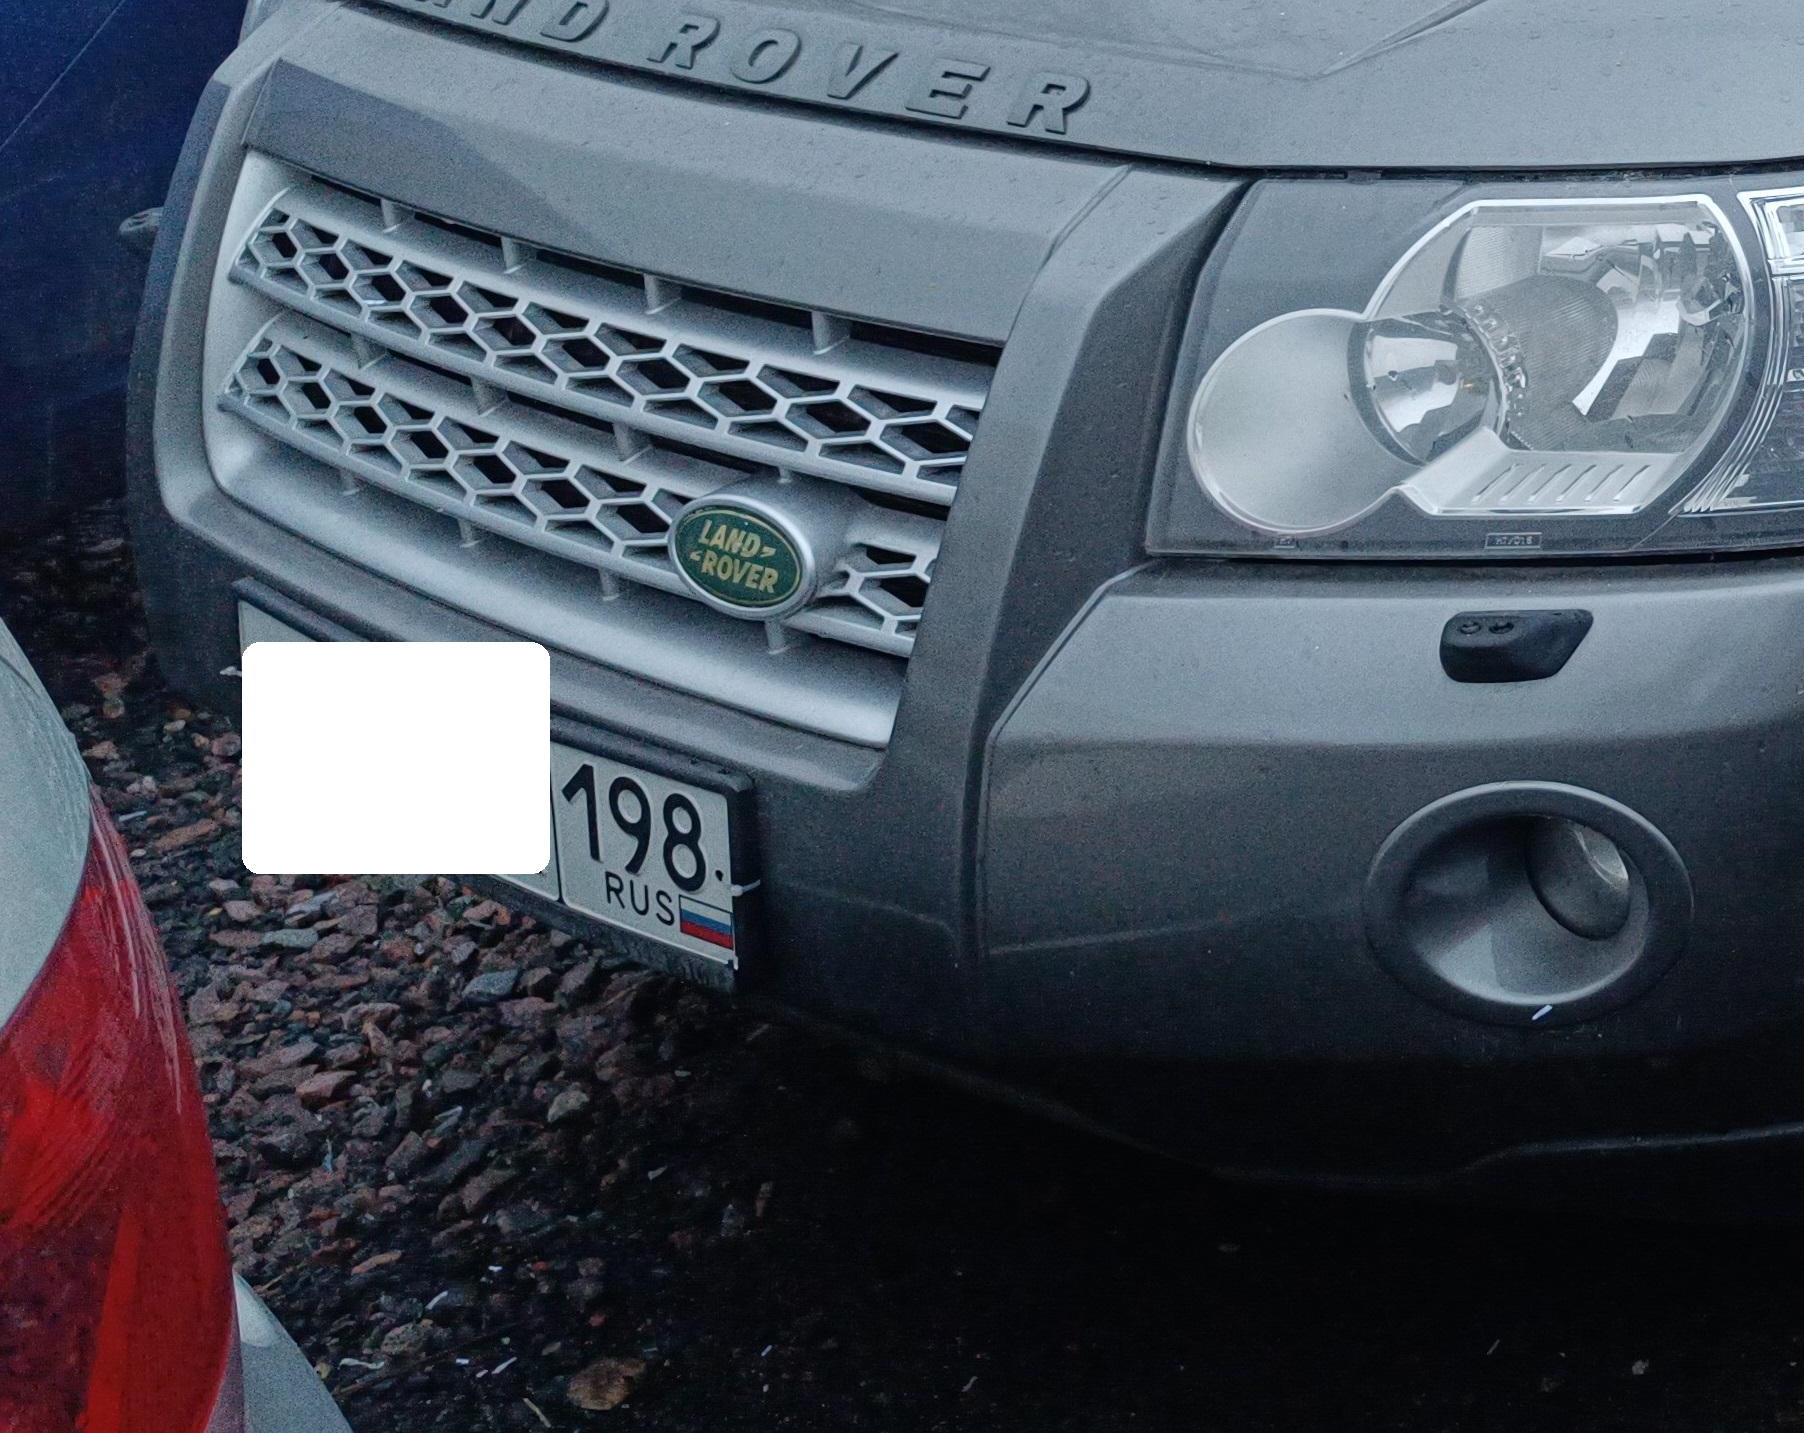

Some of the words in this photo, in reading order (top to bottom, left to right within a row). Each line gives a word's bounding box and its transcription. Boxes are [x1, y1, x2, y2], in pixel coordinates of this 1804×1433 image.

[646, 13, 1093, 136] ROVER
[700, 549, 779, 593] ROVER
[561, 763, 707, 893] 198
[604, 870, 676, 927] RUS
